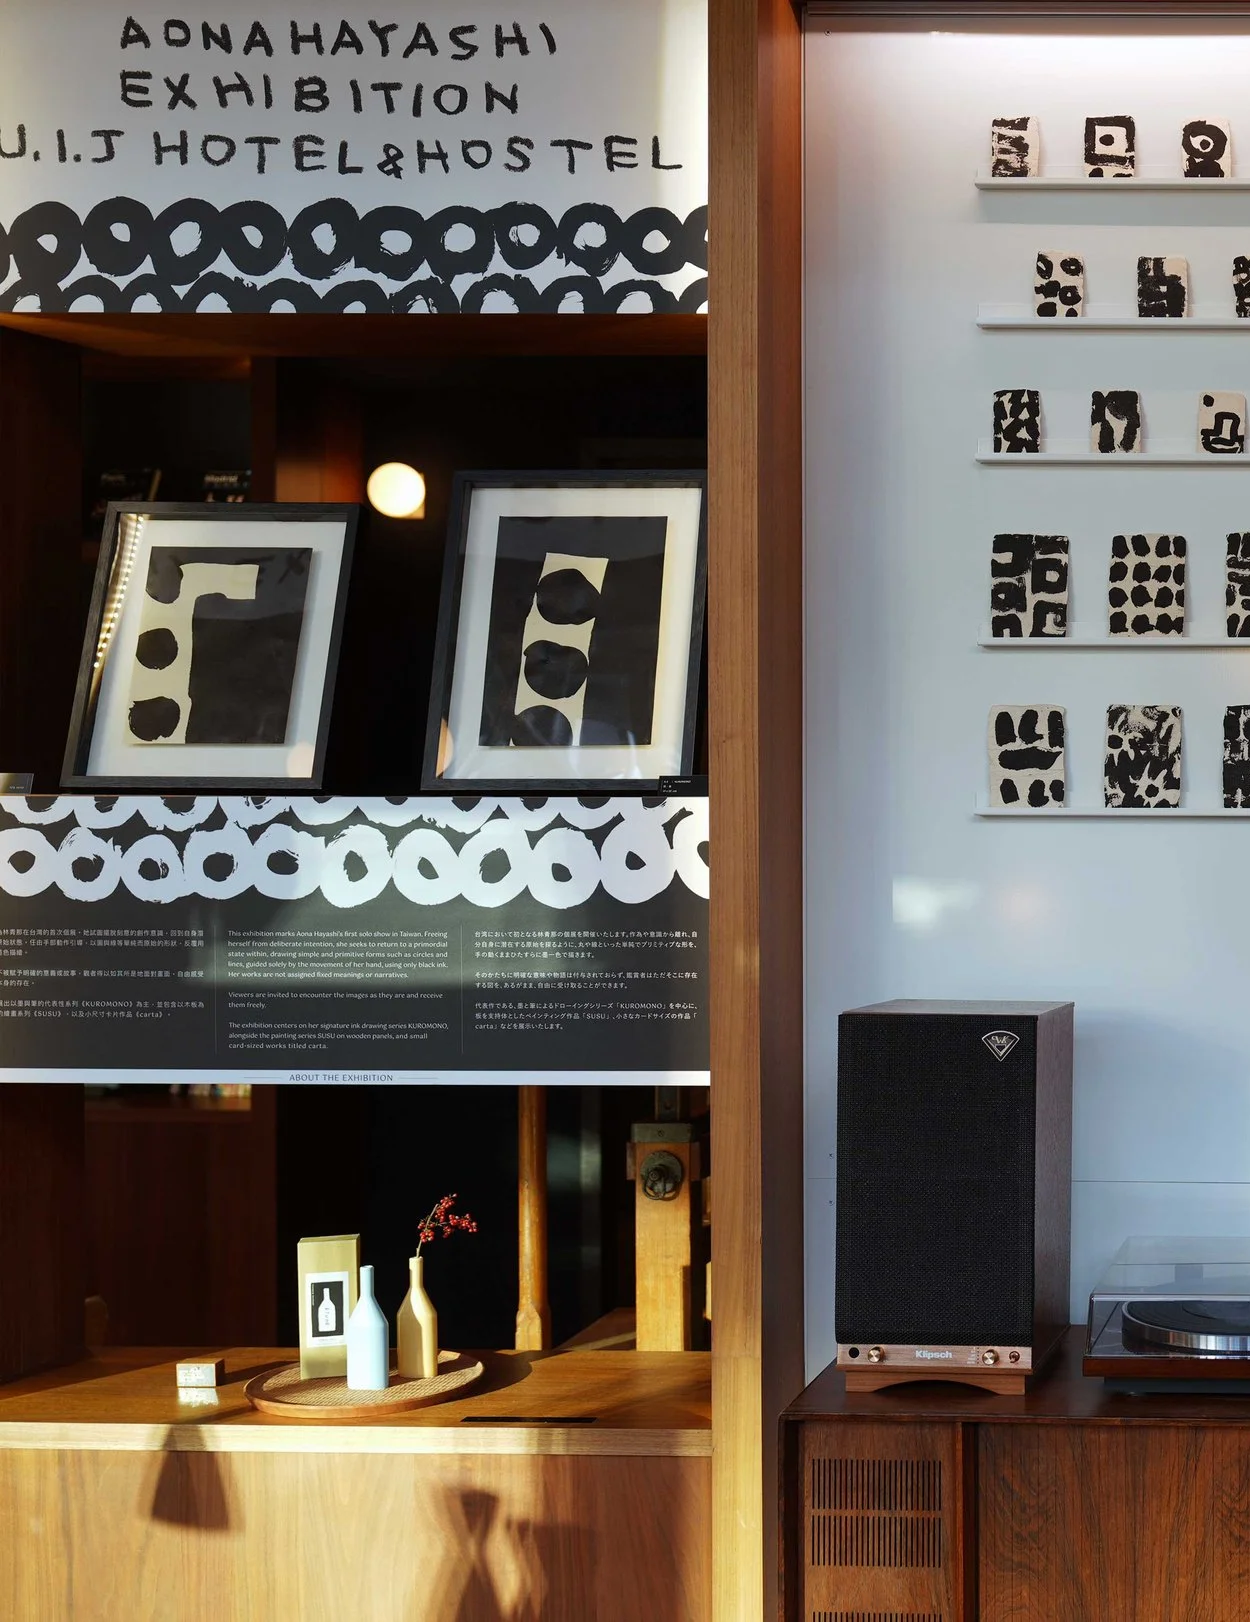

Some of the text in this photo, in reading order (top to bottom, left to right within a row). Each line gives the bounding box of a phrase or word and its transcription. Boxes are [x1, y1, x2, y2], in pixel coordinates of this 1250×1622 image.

[120, 70, 518, 117] EXHIBITION
[0, 124, 124, 163] U.I.J
[314, 930, 344, 939] Hayashi's
[424, 930, 448, 939] Freeing
[303, 940, 335, 949] intention,
[413, 940, 448, 949] primordial
[246, 950, 269, 959] within,
[269, 950, 297, 959] drawing
[298, 950, 320, 959] simple
[334, 950, 365, 959] primitive
[227, 960, 245, 969] lines,
[245, 960, 268, 969] guided
[268, 960, 287, 969] solely
[288, 960, 297, 969] by
[365, 961, 384, 969] hand,
[384, 961, 402, 969] using
[402, 961, 418, 969] only
[287, 971, 316, 979] assigned
[333, 971, 364, 979] meanings
[345, 991, 369, 1000] images
[378, 991, 394, 1000] they
[246, 1001, 266, 1010] freely.
[320, 1022, 350, 1030] signature
[361, 1022, 388, 1030] drawing
[408, 1022, 449, 1031] KUROMONO,
[228, 1032, 258, 1040] alongside
[270, 1032, 297, 1040] painting
[372, 1032, 395, 1041] panels,
[915, 1350, 953, 1360] Klipsch
